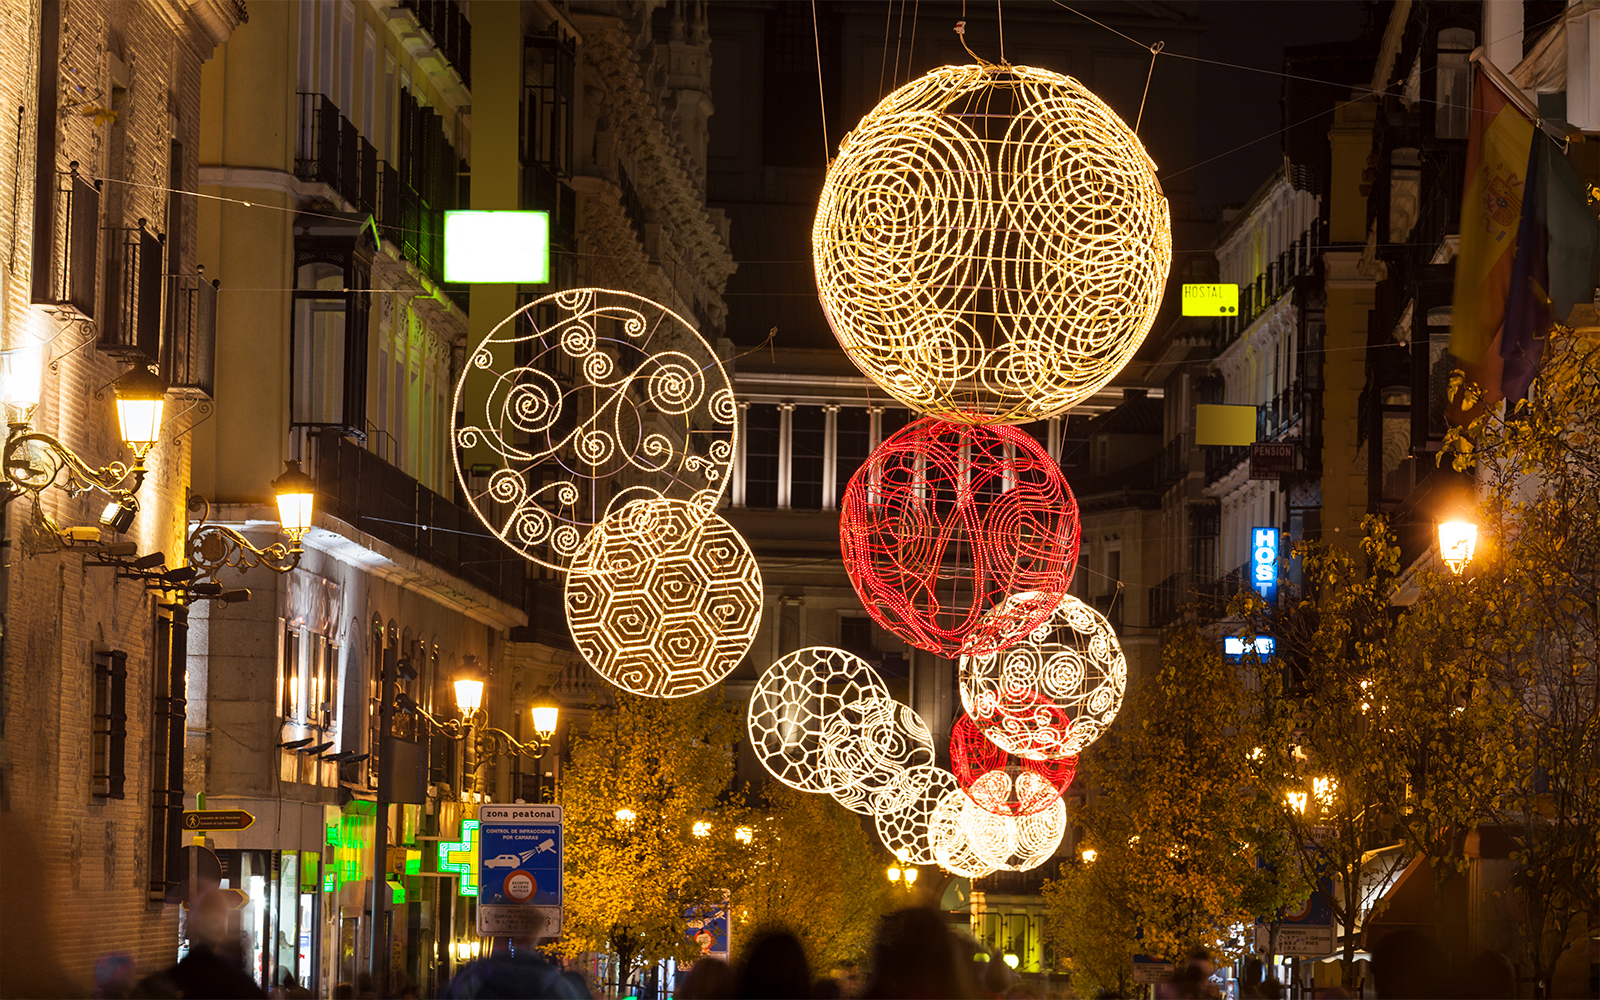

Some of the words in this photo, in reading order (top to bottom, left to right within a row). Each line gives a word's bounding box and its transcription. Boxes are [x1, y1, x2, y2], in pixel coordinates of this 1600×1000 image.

[1184, 286, 1224, 298] HOSTAL
[1253, 446, 1291, 456] PENSION
[512, 810, 555, 819] peatonal
